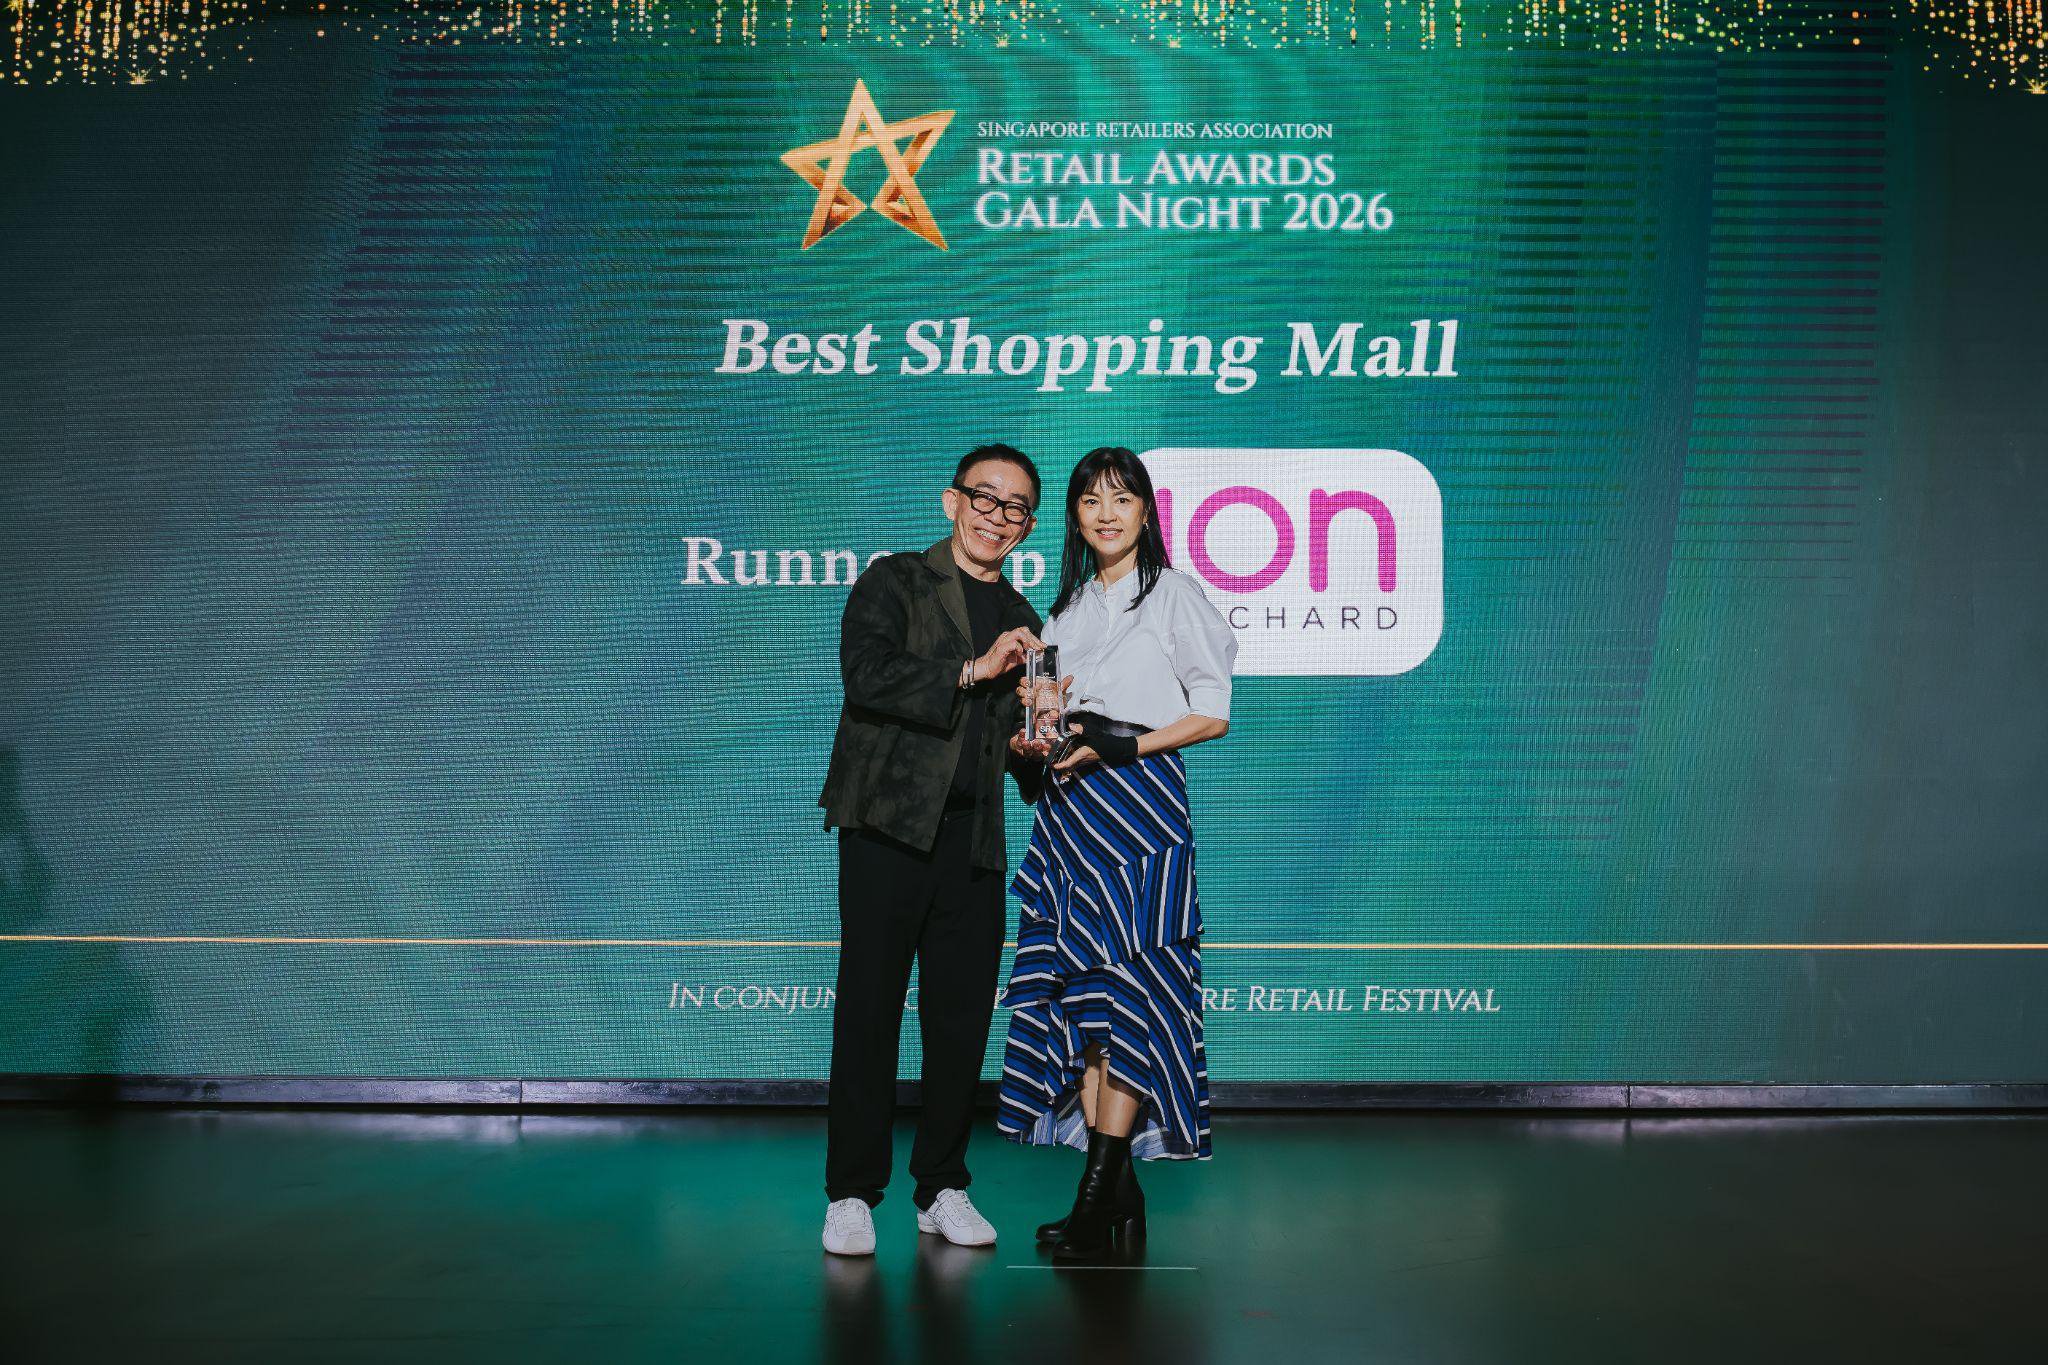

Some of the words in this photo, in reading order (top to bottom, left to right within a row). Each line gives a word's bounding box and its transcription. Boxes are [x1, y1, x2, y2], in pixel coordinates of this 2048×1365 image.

[977, 121, 1090, 138] SINGAPORE
[1096, 122, 1195, 138] RETAILERS
[1200, 122, 1333, 139] ASSOCIATION
[977, 147, 1133, 184] RETAIL
[1143, 149, 1336, 186] AWARDS
[974, 191, 1102, 229] GALA
[1115, 191, 1270, 230] NIGHT
[1283, 192, 1393, 230] 2026
[714, 318, 881, 375] Best
[900, 317, 1263, 394] Shopping
[1280, 319, 1458, 377] Mall
[681, 536, 893, 586] Runn
[1229, 606, 1398, 629] CHARD
[669, 983, 706, 1008] IN
[1248, 985, 1352, 1011] RETAIL
[1363, 985, 1501, 1013] FESTIVAL
